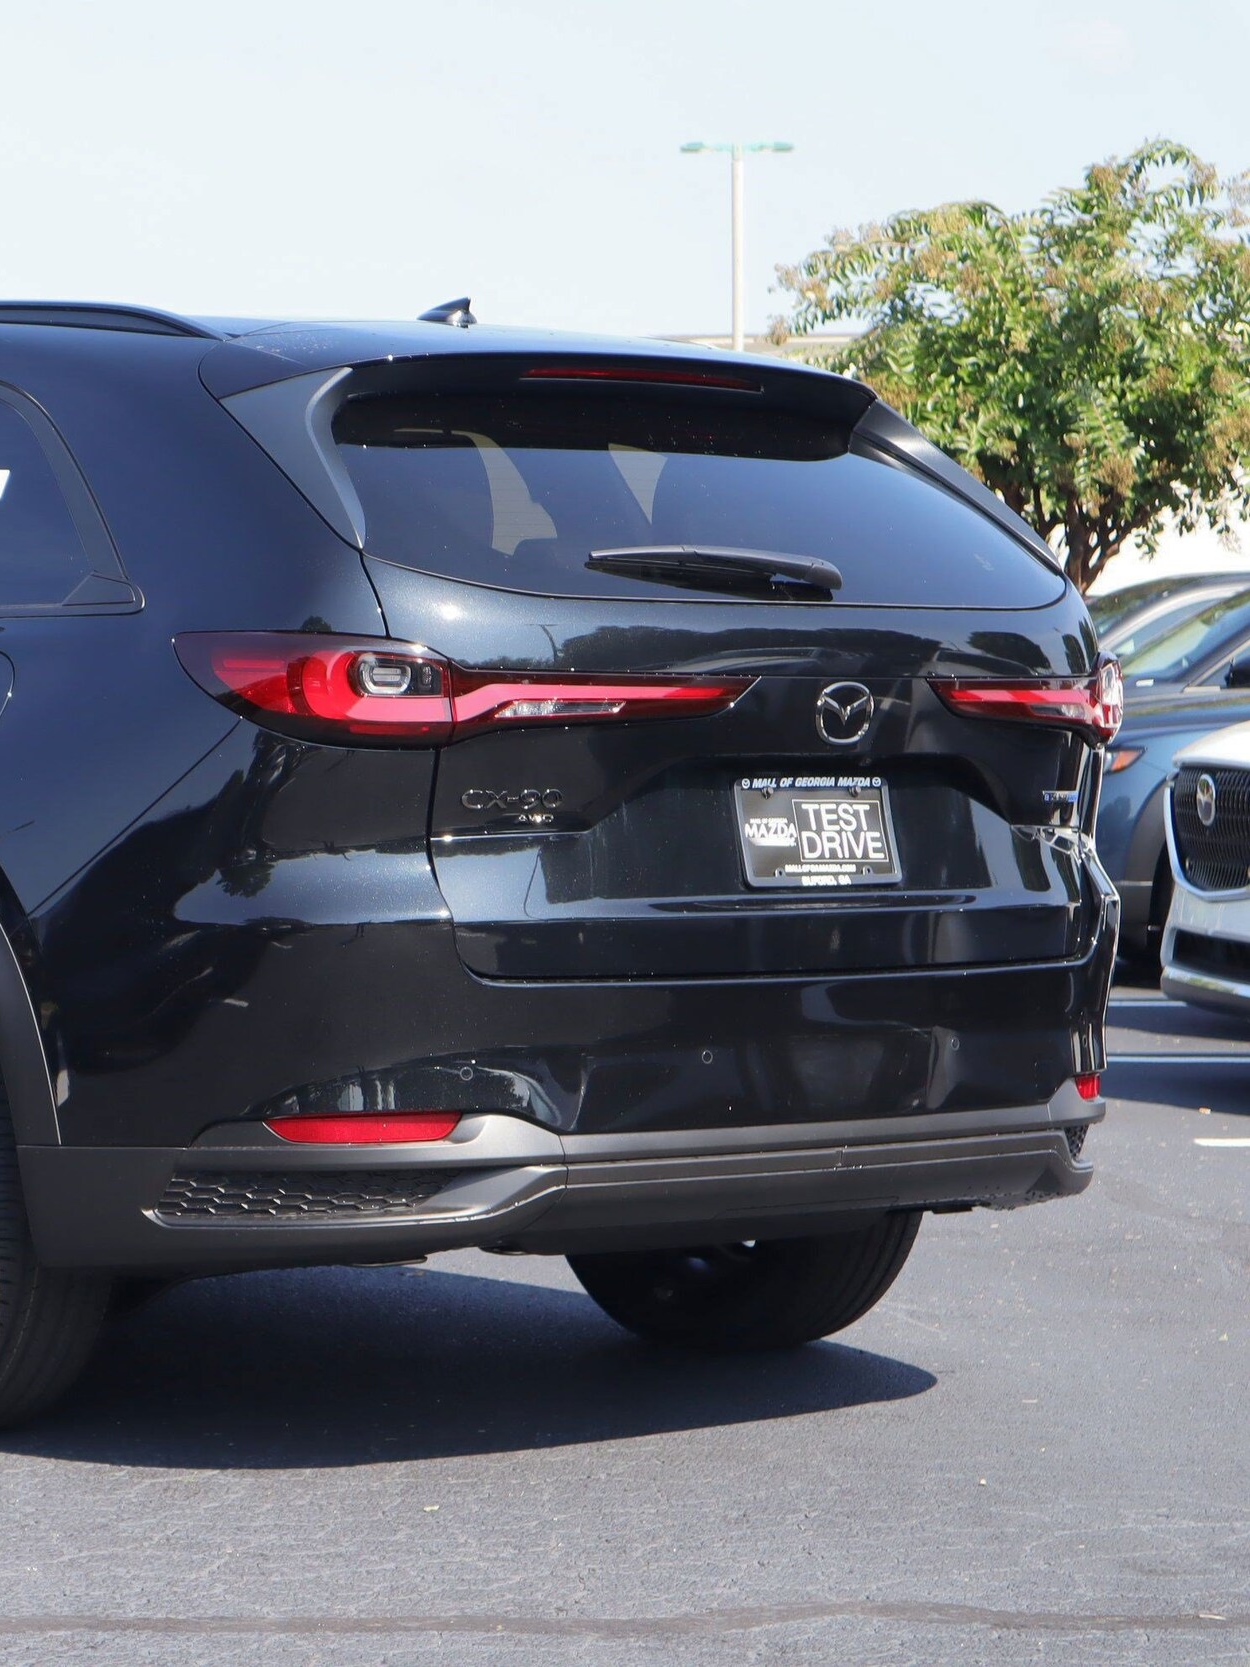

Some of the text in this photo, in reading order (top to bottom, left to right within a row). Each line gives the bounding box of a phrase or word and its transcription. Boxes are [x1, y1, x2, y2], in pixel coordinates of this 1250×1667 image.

[752, 777, 871, 788] MALL OF GEORGIA MAZDA
[461, 788, 564, 809] CX-90
[801, 803, 870, 831] TEST
[745, 822, 797, 838] MAZDA
[801, 831, 885, 859] DRIVE
